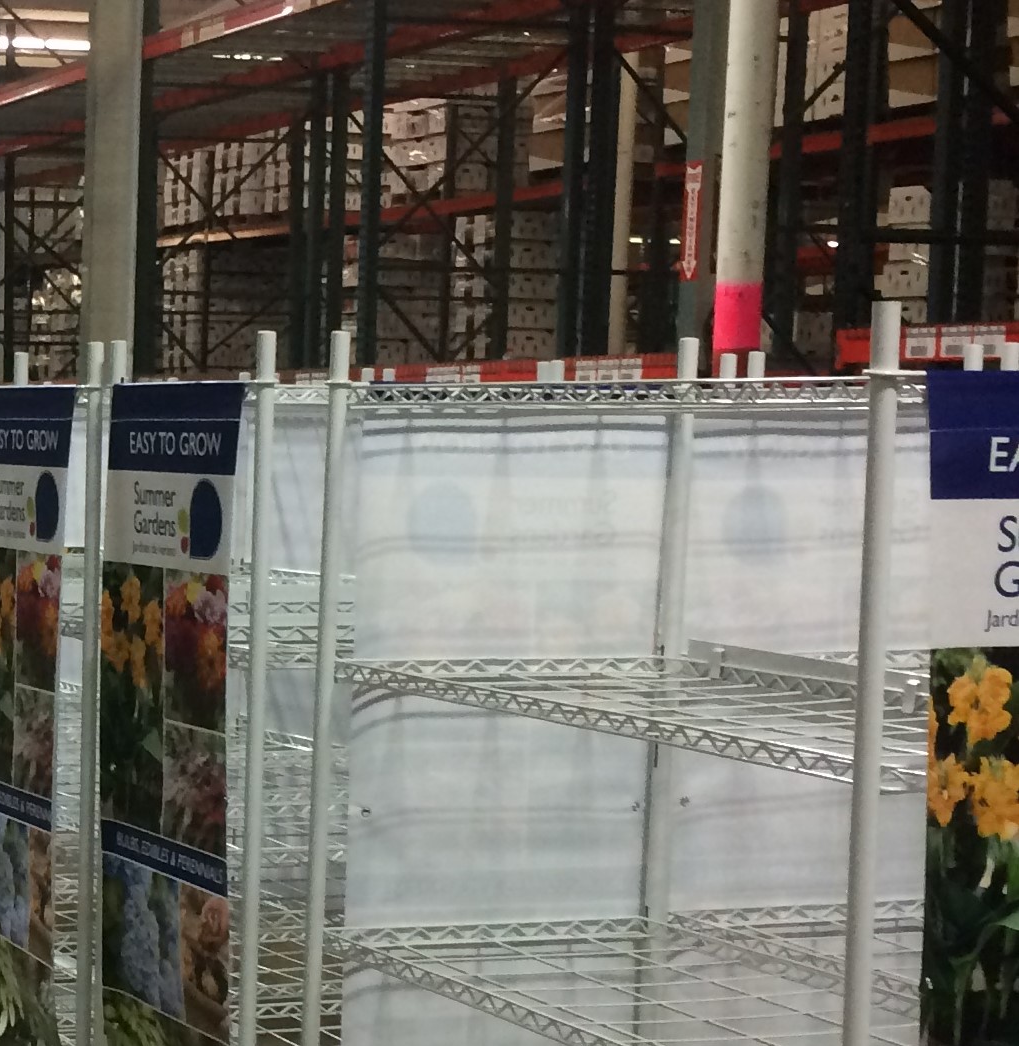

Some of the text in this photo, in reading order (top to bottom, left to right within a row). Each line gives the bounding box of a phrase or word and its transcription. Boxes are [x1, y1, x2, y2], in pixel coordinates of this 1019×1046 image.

[10, 428, 24, 450] TO
[26, 428, 59, 451] GROW
[129, 431, 222, 457] EASY TO GROW
[133, 480, 177, 508] Summer
[133, 510, 177, 538] Gardens
